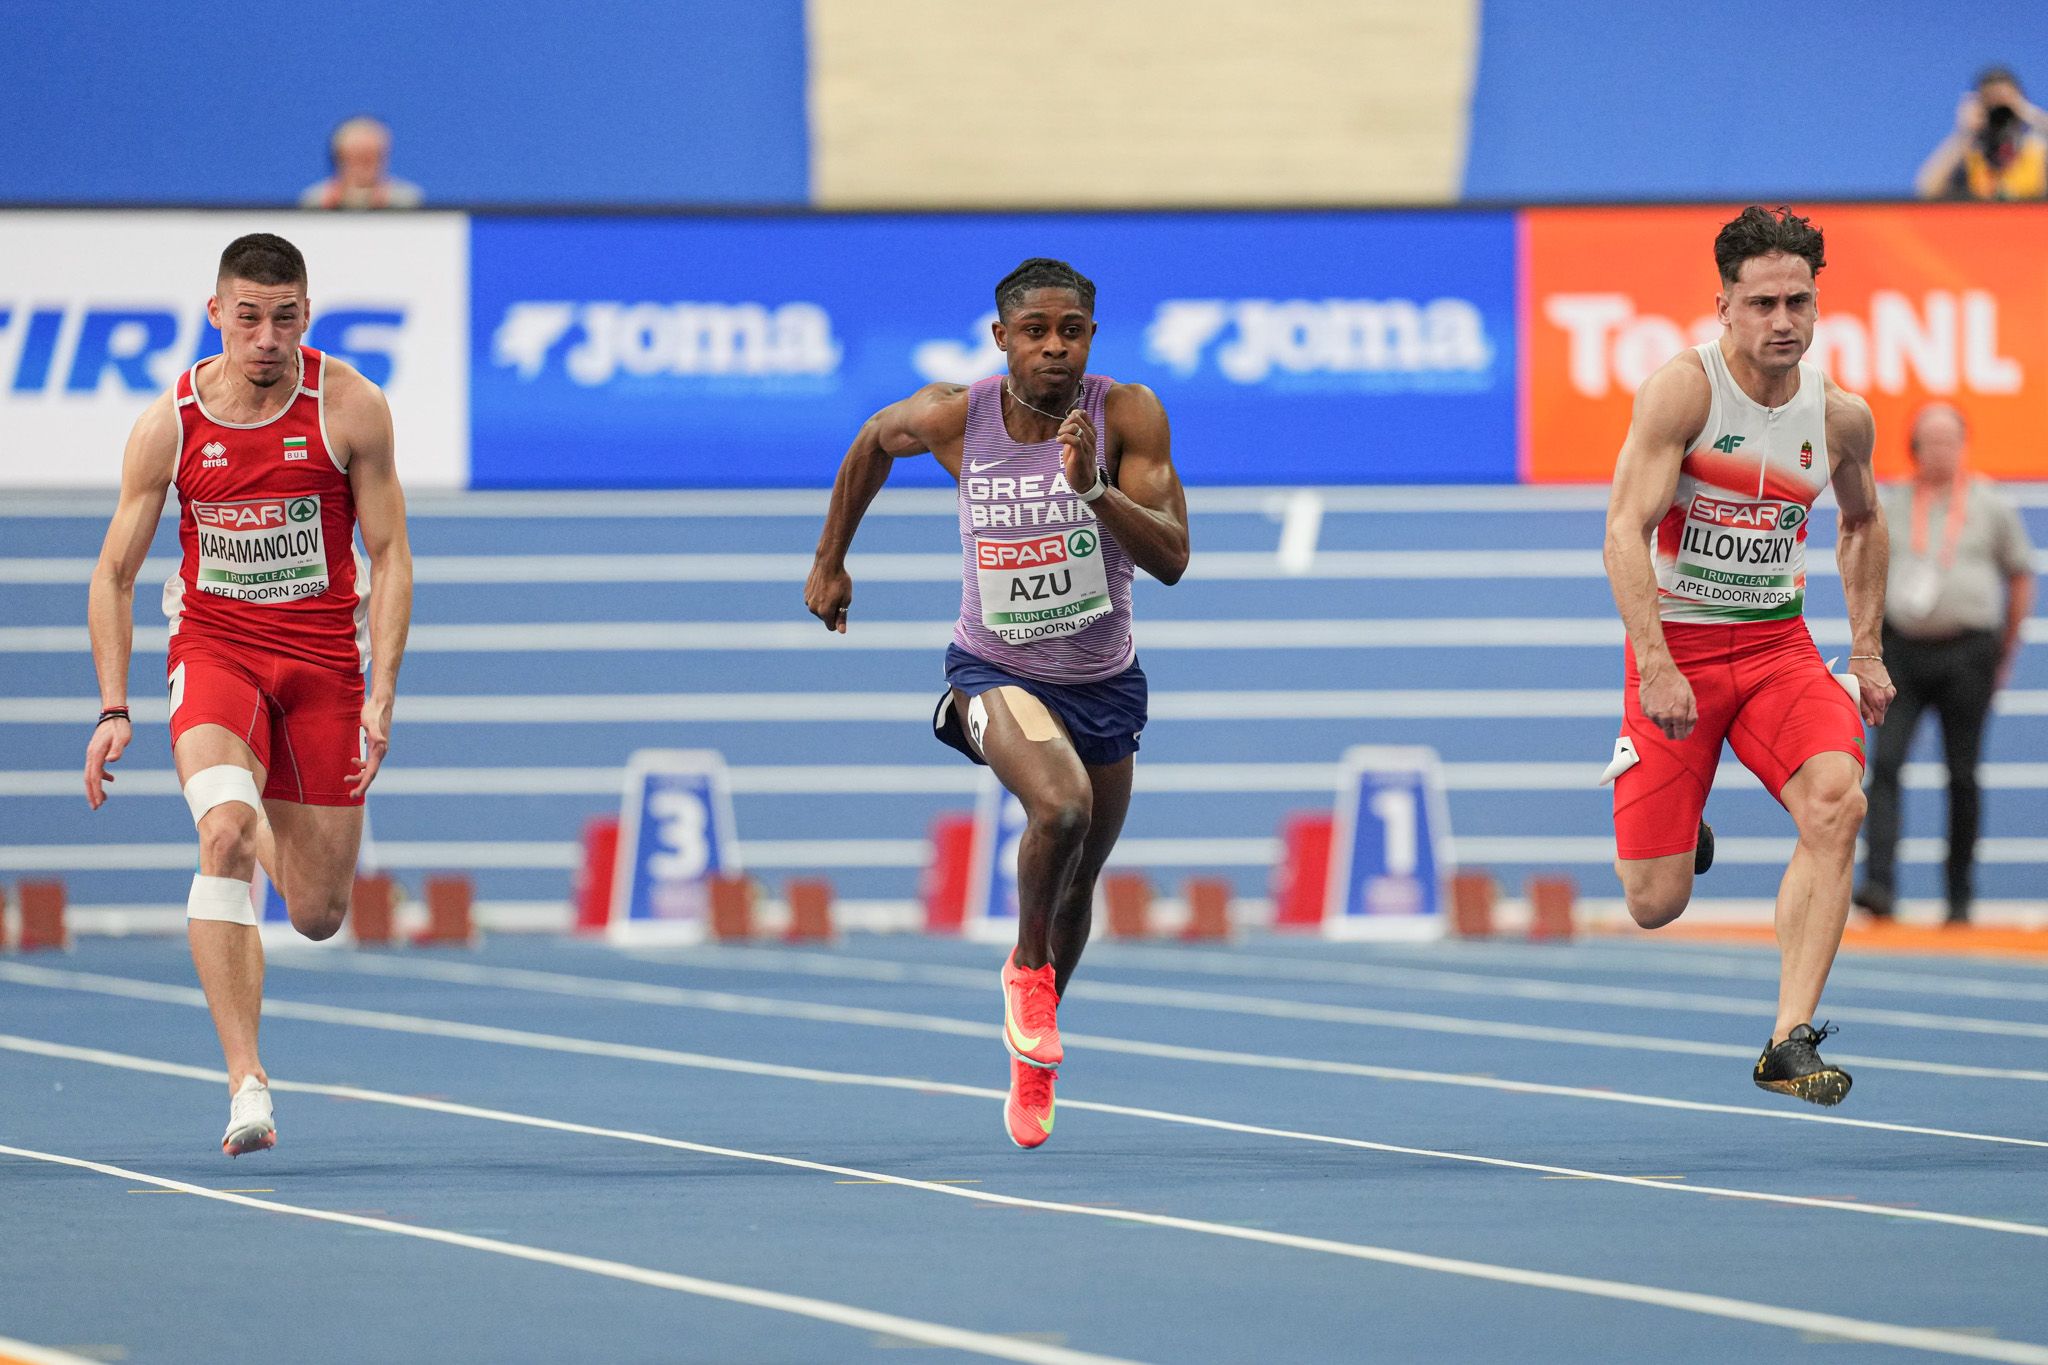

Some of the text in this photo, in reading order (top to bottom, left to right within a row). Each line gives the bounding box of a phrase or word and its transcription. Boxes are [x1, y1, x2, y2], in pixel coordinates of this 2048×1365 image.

[968, 473, 1075, 500] GREA
[197, 505, 284, 527] SPAR
[1693, 500, 1779, 526] SPAR
[200, 527, 318, 563] KARAMANOLOV
[980, 541, 1064, 566] SPAR
[1682, 525, 1794, 564] ILLOVSZKY
[231, 573, 254, 583] RUN
[293, 581, 324, 595] 2025
[1010, 569, 1072, 601] AZU
[1707, 570, 1735, 583] RUN
[1676, 580, 1791, 605] APELDOORN 2025
[1015, 611, 1041, 622] RUN
[649, 789, 709, 881] 3
[1372, 790, 1417, 876] 1
